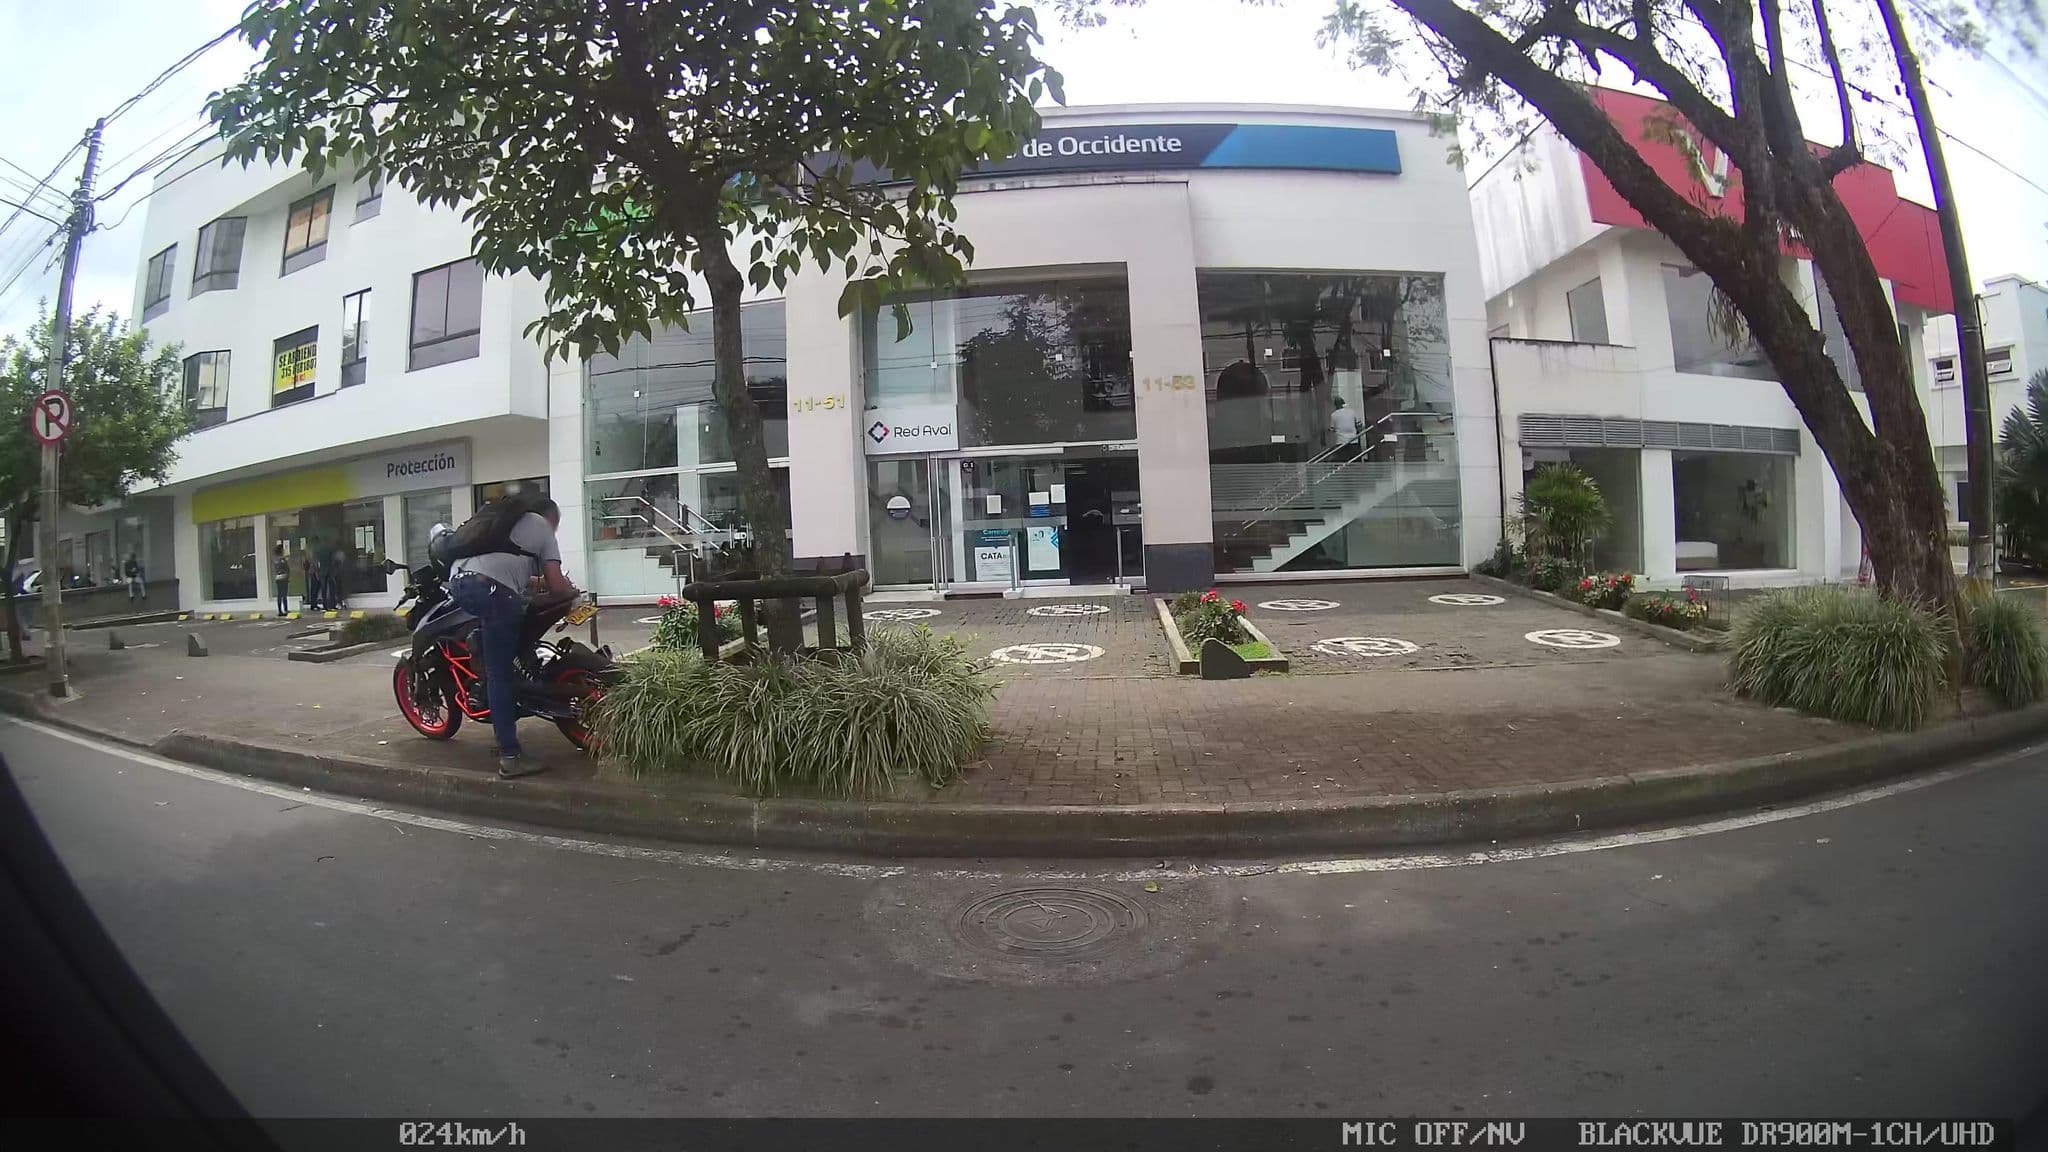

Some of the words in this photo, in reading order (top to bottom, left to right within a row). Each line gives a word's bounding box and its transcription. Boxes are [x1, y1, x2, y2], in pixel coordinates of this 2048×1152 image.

[1023, 139, 1053, 157] de
[1057, 134, 1182, 156] Occidente
[793, 393, 845, 412] 11-51
[894, 425, 920, 438] Red
[923, 423, 952, 436] Aval
[387, 452, 456, 478] Protección
